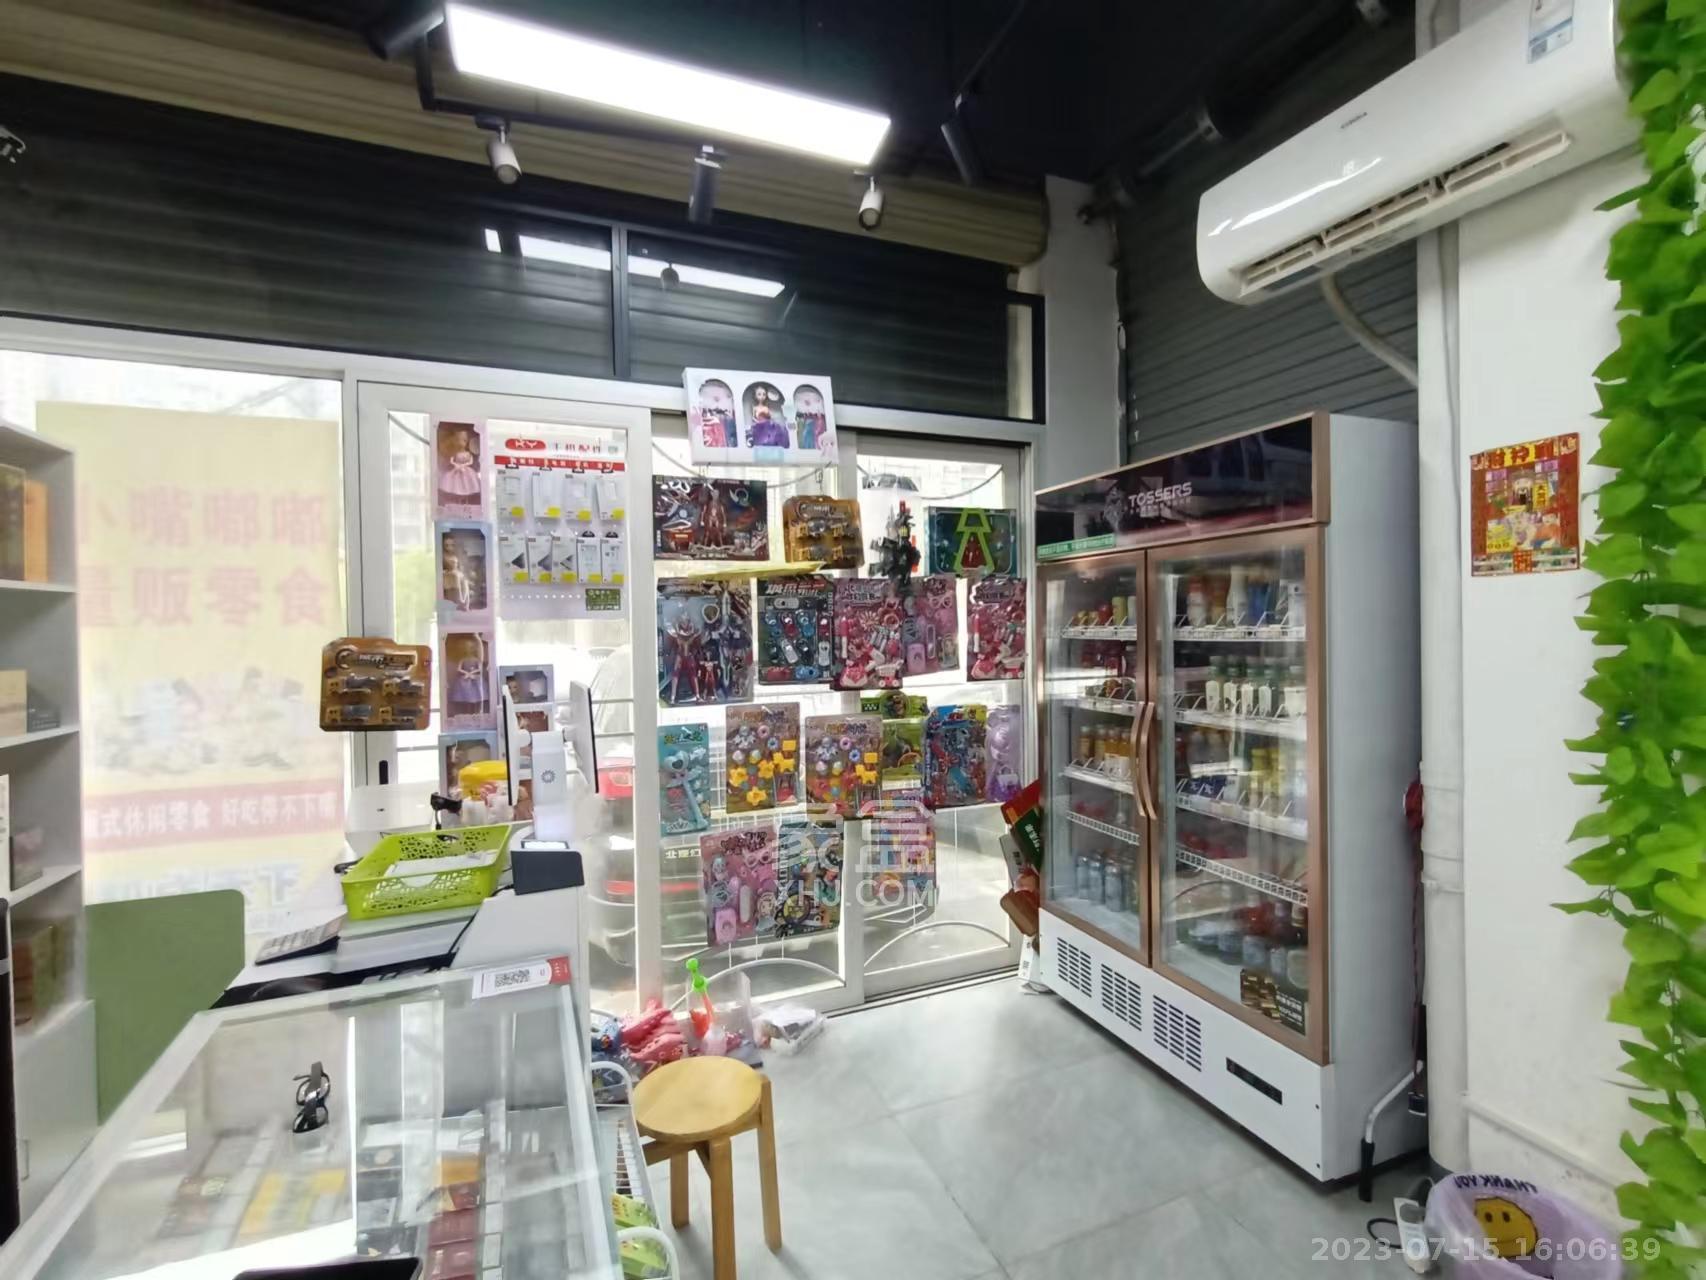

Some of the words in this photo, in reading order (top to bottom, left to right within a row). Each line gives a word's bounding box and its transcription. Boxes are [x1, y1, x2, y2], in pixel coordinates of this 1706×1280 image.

[1128, 481, 1193, 507] TOSSERS
[79, 564, 329, 627] 量贩零食
